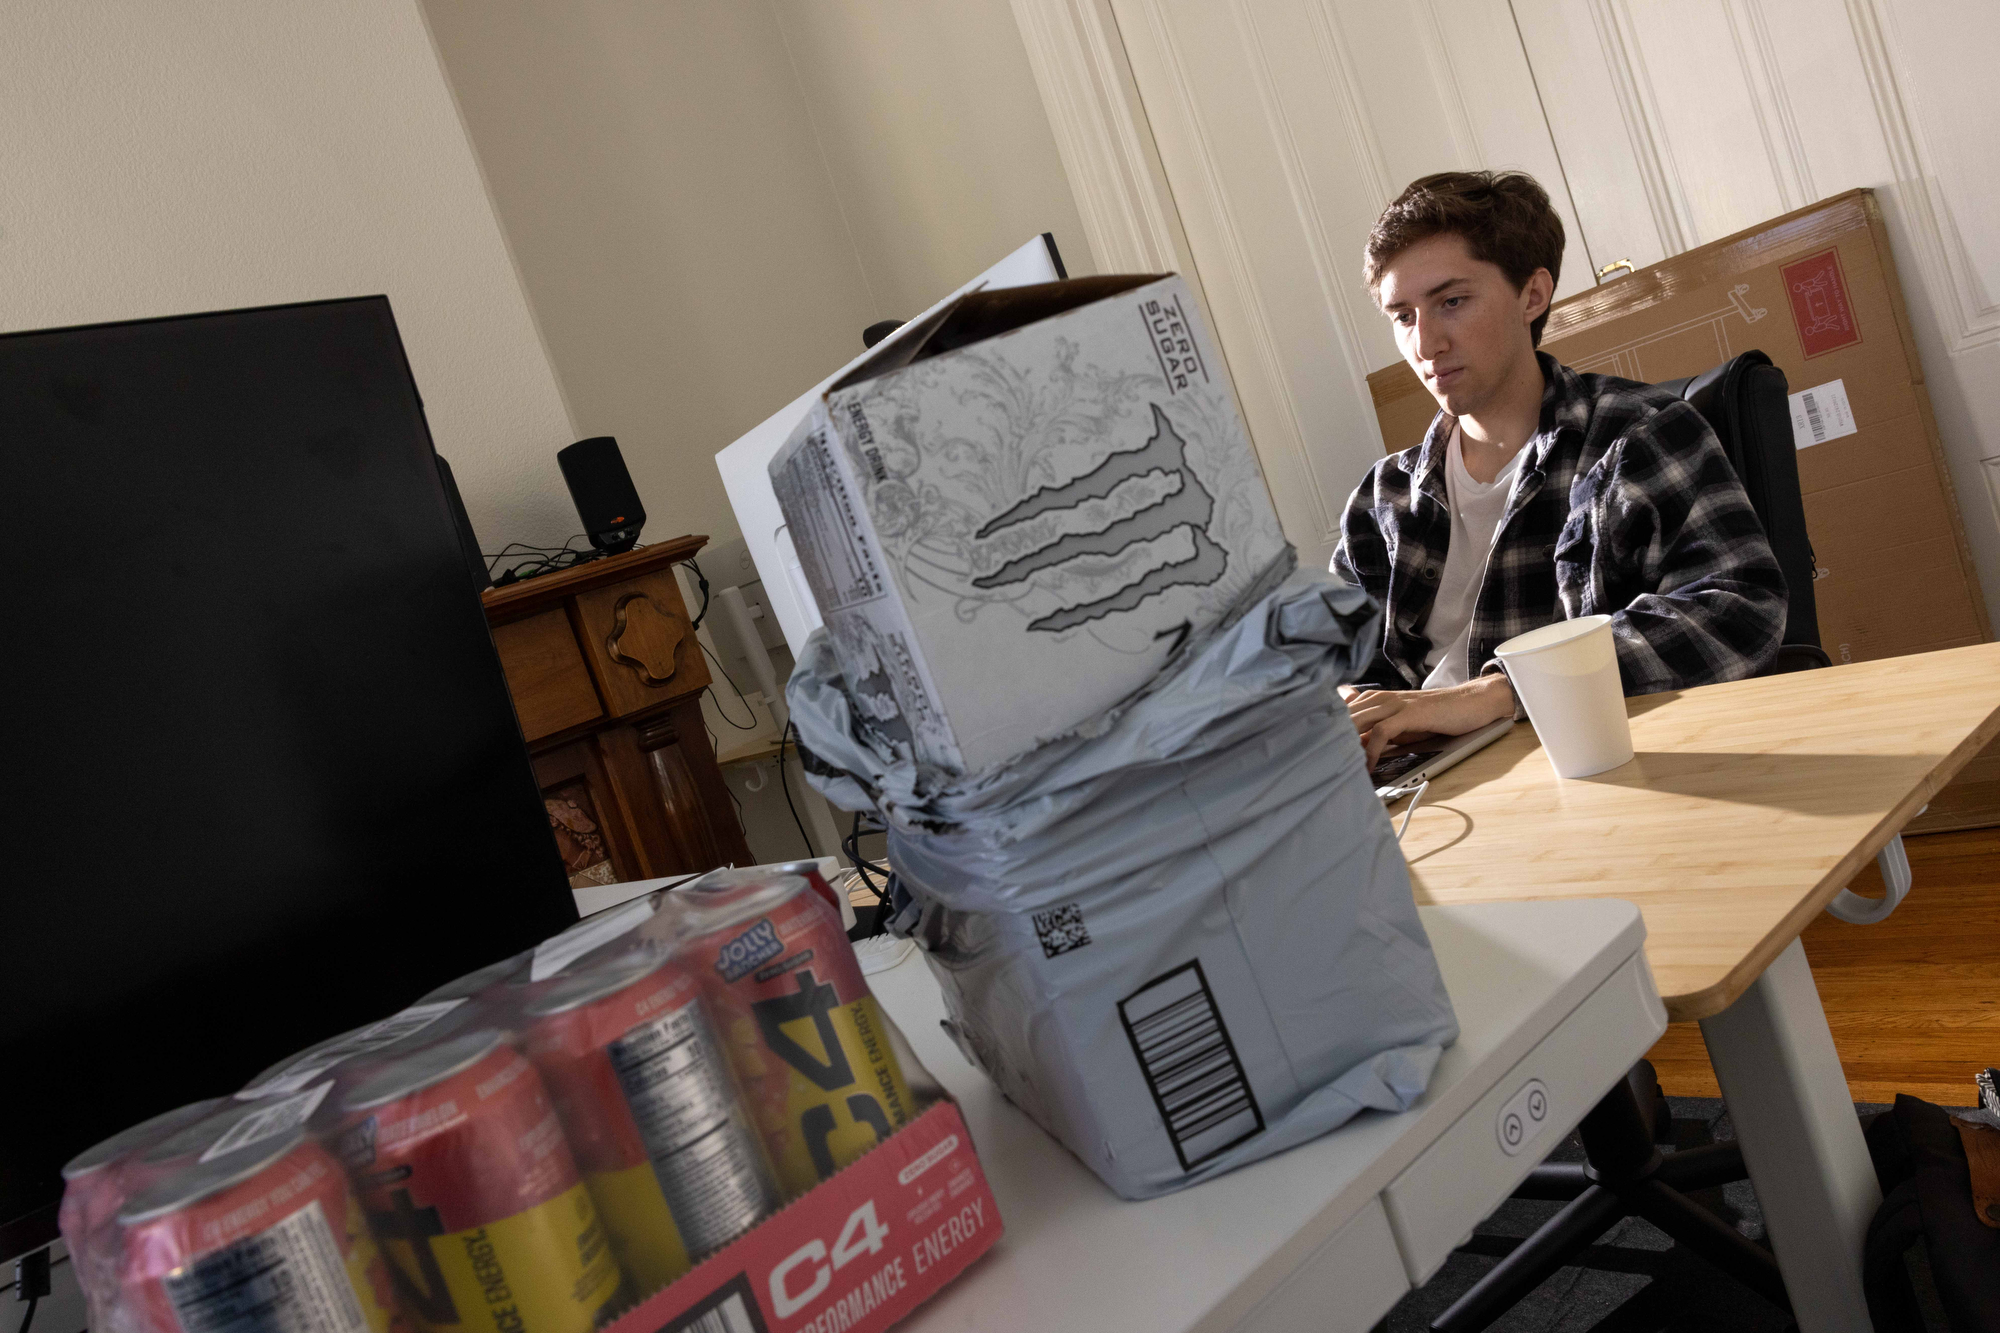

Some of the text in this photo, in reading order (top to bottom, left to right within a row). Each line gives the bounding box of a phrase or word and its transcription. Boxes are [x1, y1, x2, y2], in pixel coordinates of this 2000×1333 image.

[1833, 289, 1840, 297] TO
[1836, 299, 1844, 312] WAY
[1145, 300, 1188, 390] SUGAR
[1163, 305, 1198, 374] ZERO
[847, 402, 888, 484] ENERGY DRINK
[717, 921, 776, 971] JOLLY
[769, 1199, 890, 1320] C4
[795, 1256, 907, 1333] RFORMANCE
[912, 1196, 985, 1275] ENERGY
